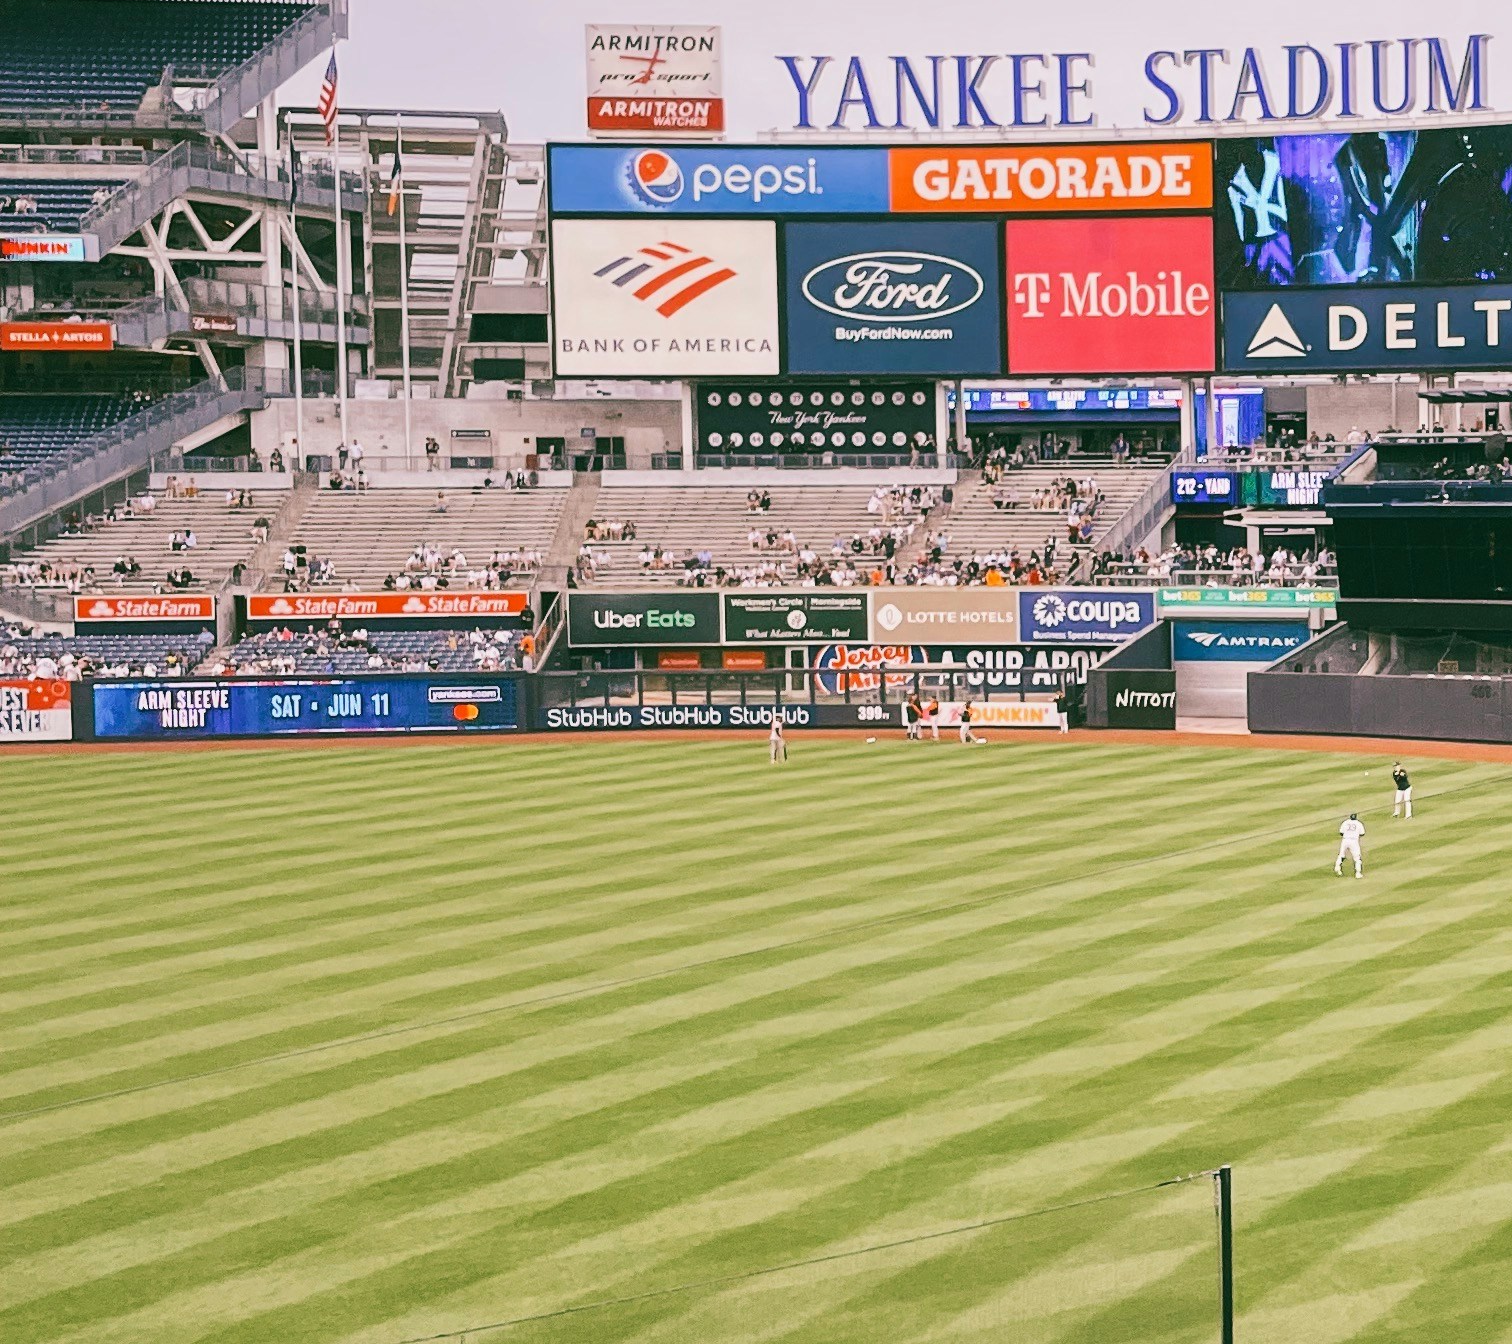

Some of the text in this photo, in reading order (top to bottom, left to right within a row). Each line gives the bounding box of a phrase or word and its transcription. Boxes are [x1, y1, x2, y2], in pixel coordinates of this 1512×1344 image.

[590, 35, 714, 52] ARMITRON
[775, 34, 1495, 129] YANKEE STADIUM
[599, 101, 710, 117] ARMITRON
[654, 117, 708, 127] WATCHES
[693, 158, 819, 202] pepsi
[913, 156, 1192, 200] GATORADE
[834, 260, 952, 310] Ford
[9, 332, 104, 342] STELLA ARTOIS
[562, 339, 772, 353] BANK OF AMERICA
[768, 411, 793, 424] New
[1271, 472, 1296, 489] ARM
[1287, 489, 1319, 505] NIGHT
[1163, 590, 1201, 602] bet365
[1228, 590, 1267, 602] bet365
[1295, 591, 1336, 602] bet365
[594, 609, 696, 628] Uber Eats
[907, 611, 1013, 623] LOTTE HOTELS
[1067, 600, 1140, 628] coupa
[1216, 636, 1296, 647] AMTRAK
[832, 645, 911, 670] Jersey
[967, 650, 1023, 685] SUB
[138, 689, 229, 711] ARM SLEEVE
[271, 693, 389, 718] SAT JUN 11
[162, 709, 207, 728] NIGHT
[548, 706, 810, 727] StubHub StubHub StubHub
